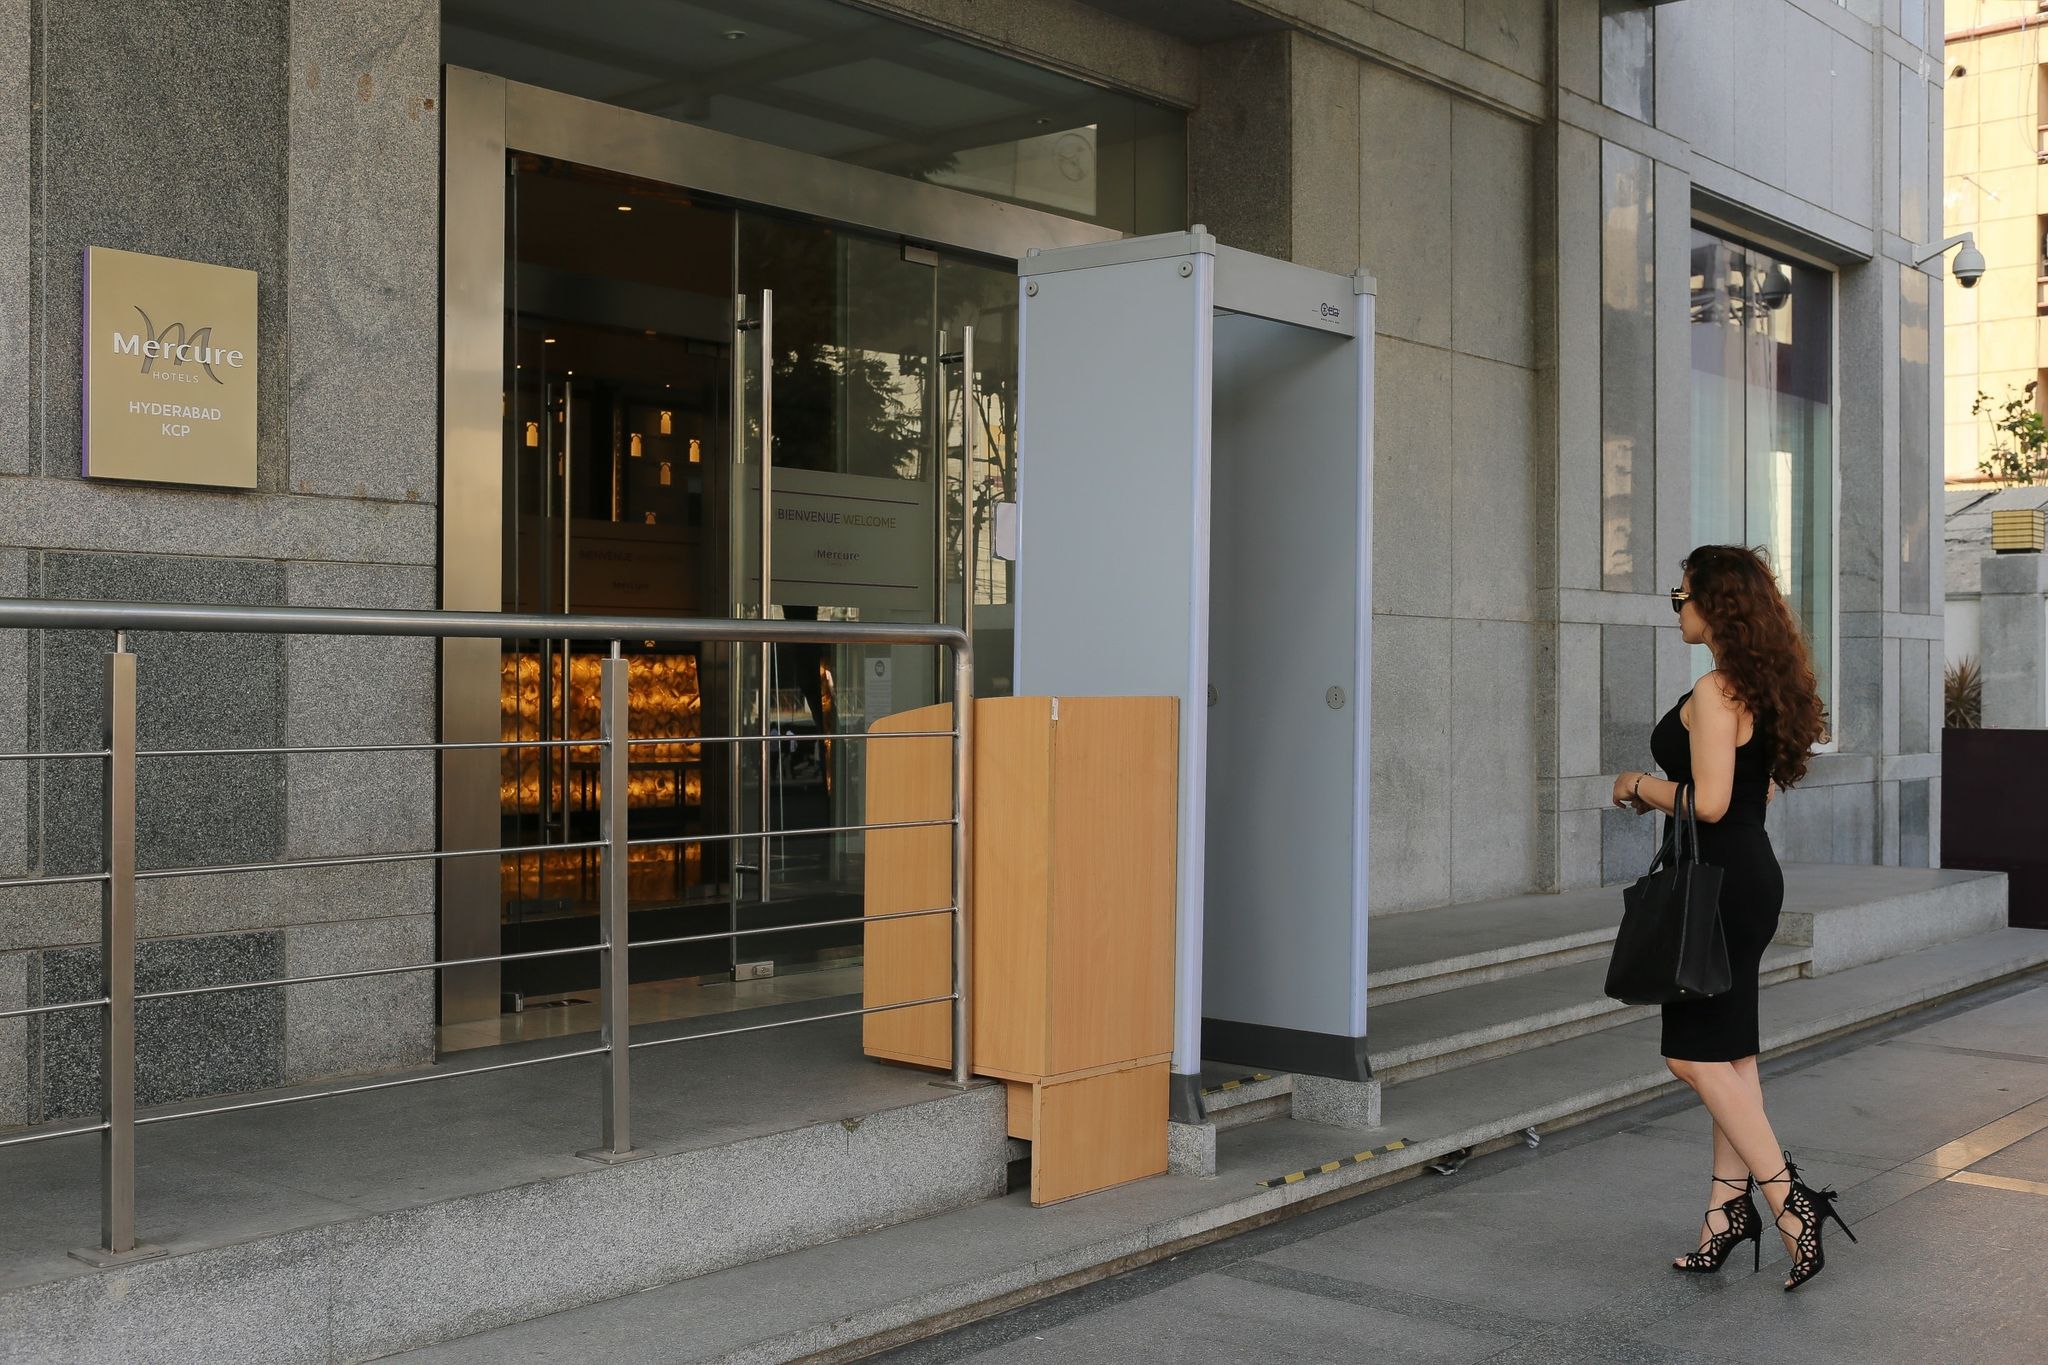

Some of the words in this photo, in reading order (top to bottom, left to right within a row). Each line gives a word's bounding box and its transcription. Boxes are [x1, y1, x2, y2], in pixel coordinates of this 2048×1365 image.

[113, 332, 244, 368] Mercure
[153, 371, 199, 383] HOTELS
[129, 401, 222, 421] HYDERABAD
[162, 423, 191, 437] KCP
[777, 508, 841, 524] BIENVENUE
[843, 514, 897, 529] WELCOME
[817, 549, 860, 561] Mercure
